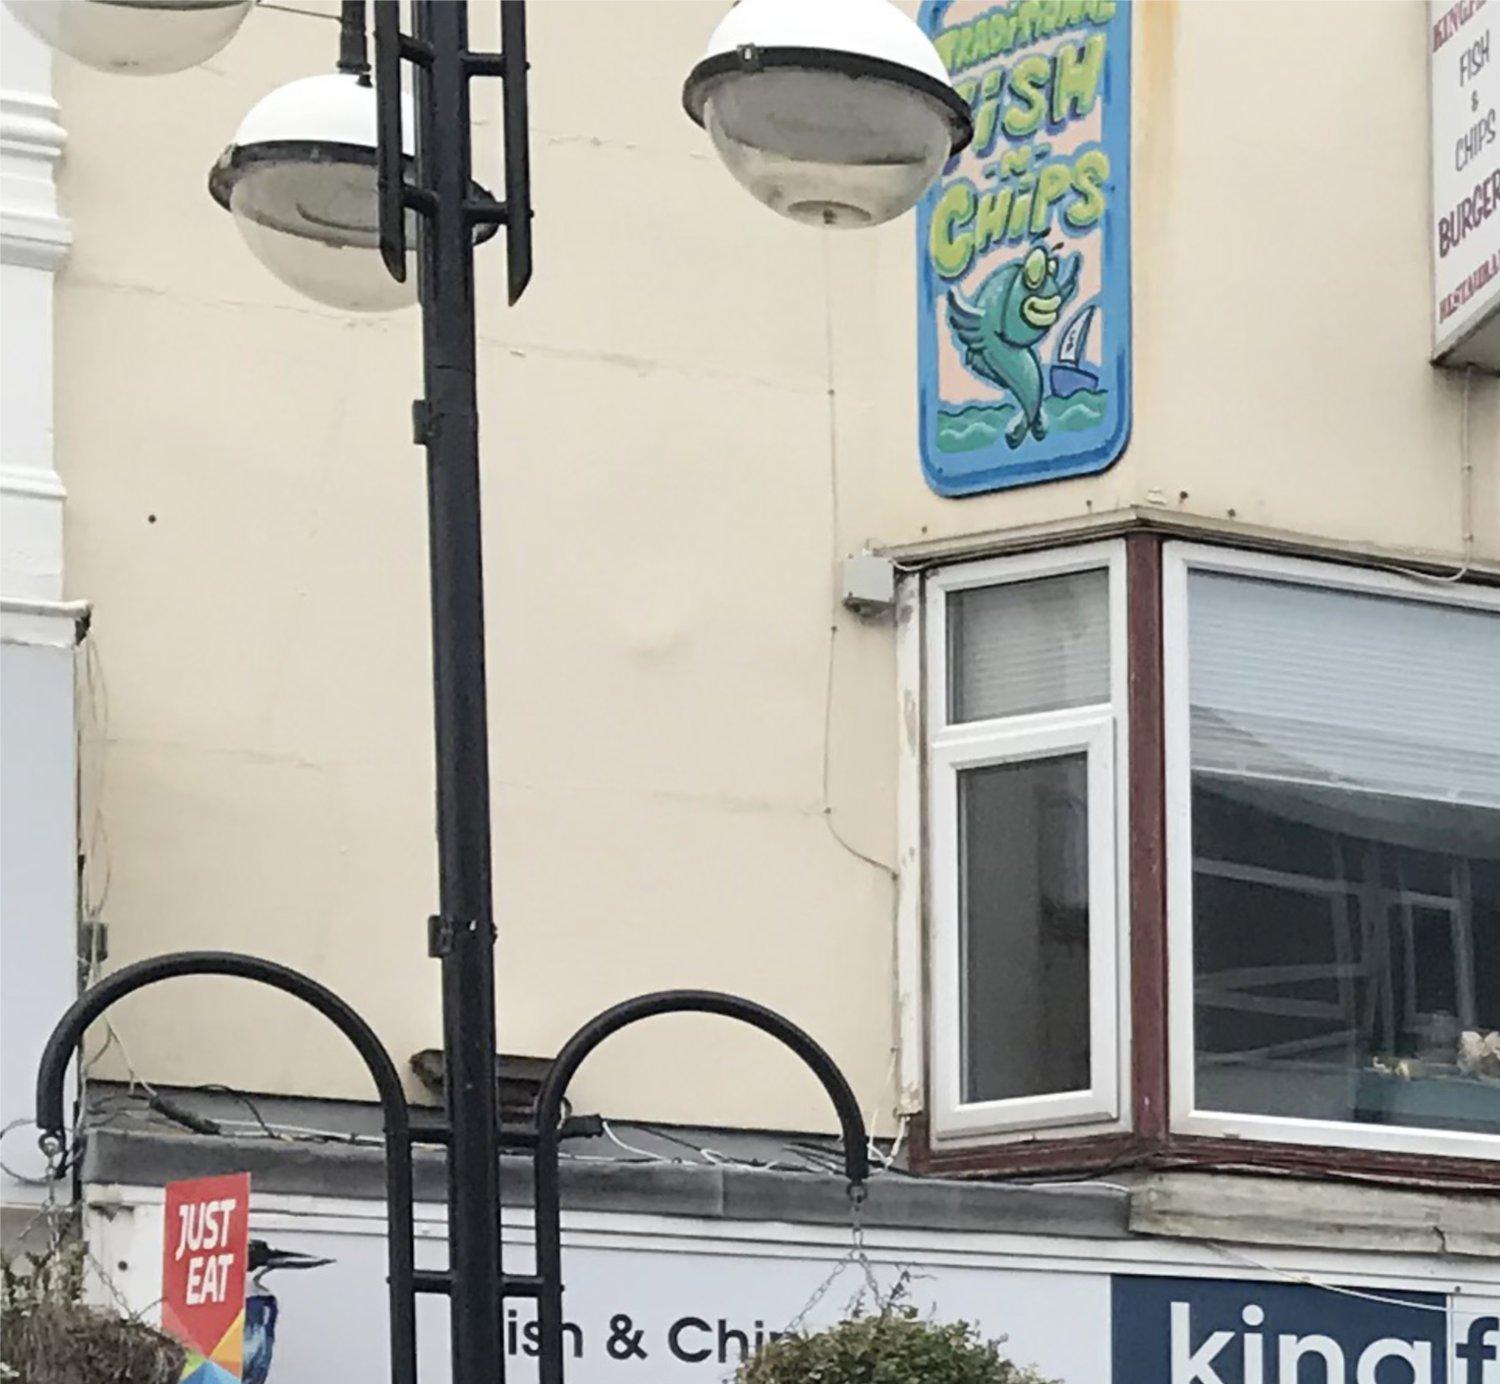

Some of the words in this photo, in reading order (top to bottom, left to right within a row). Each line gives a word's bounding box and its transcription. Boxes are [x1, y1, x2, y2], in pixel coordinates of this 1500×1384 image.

[175, 1199, 237, 1260] JUST
[186, 1253, 234, 1306] EAT
[606, 1314, 648, 1361] &
